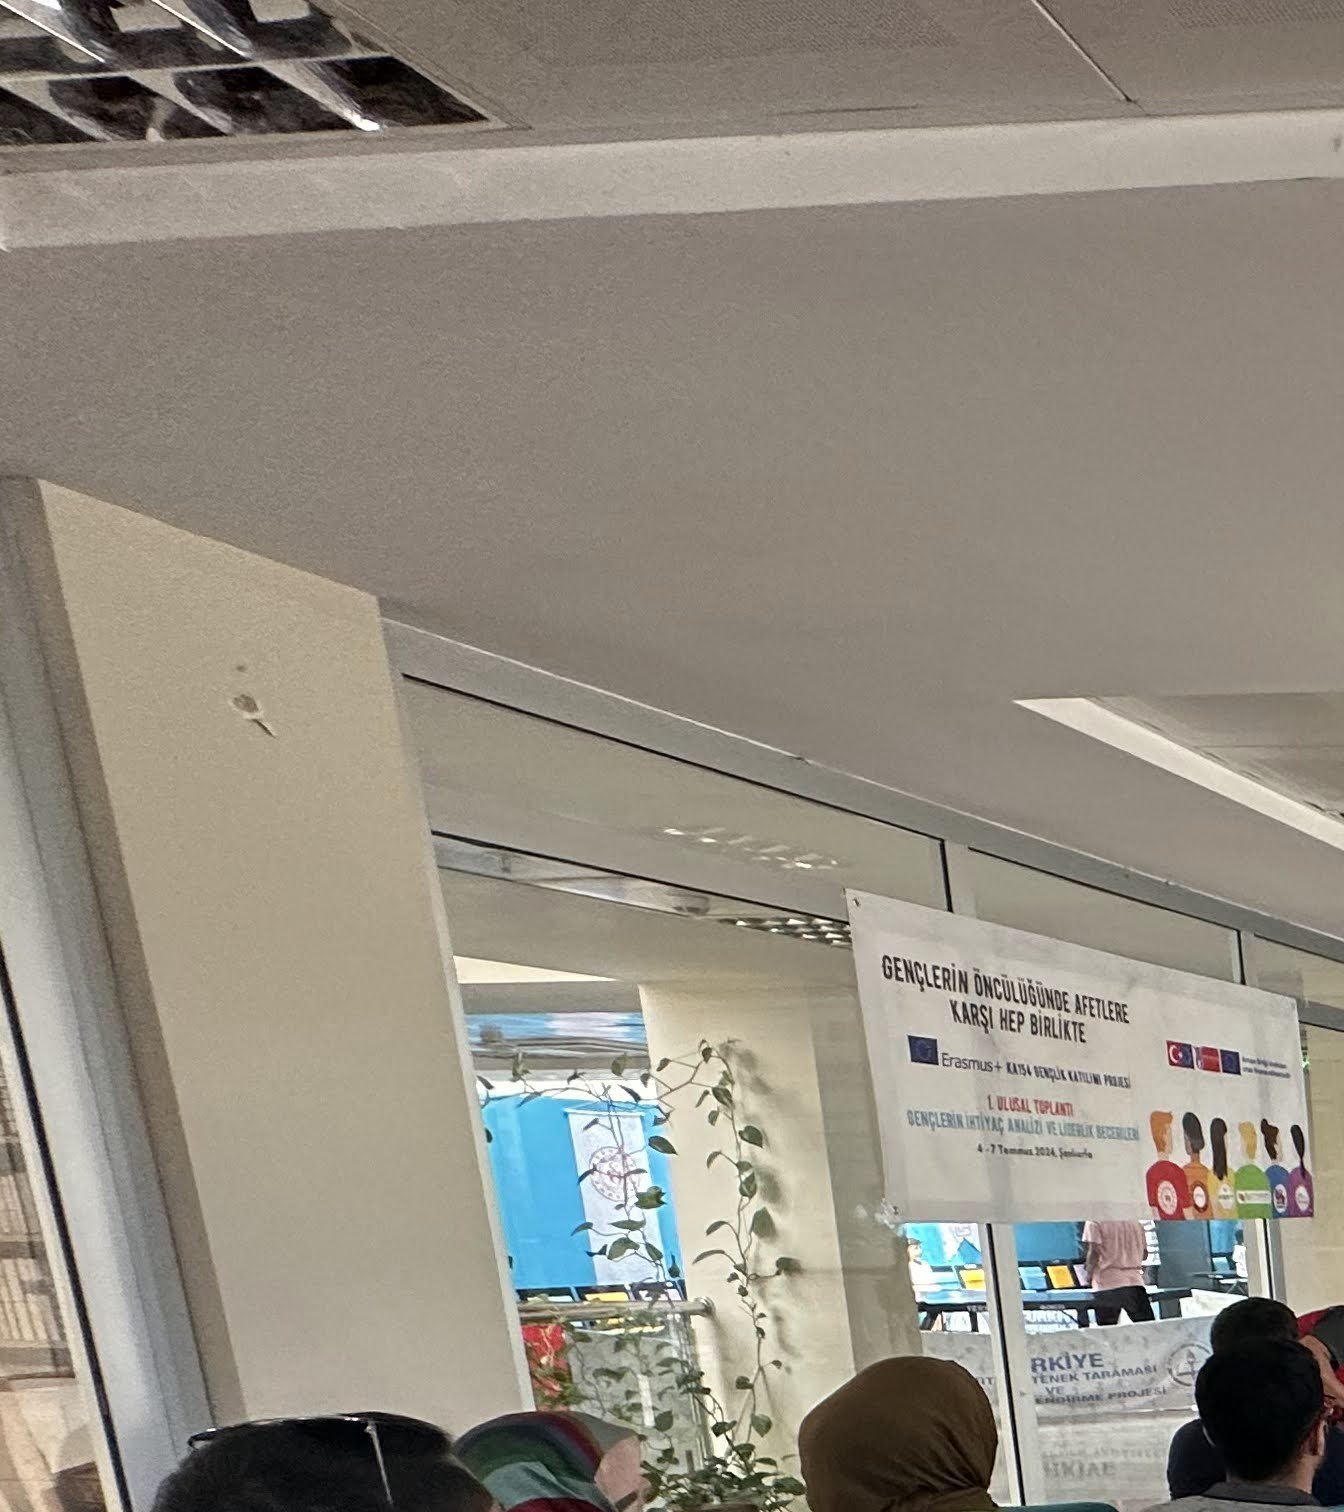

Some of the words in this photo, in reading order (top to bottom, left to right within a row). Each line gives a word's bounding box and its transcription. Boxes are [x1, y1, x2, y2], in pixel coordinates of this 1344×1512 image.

[882, 954, 968, 994] GENÇLERİN
[973, 967, 1071, 1013] ÖNCÜLÜĞÜNDE
[1075, 994, 1130, 1024] AFETLERE
[949, 999, 994, 1034] KARŞI
[1000, 1008, 1024, 1033] HEP
[1030, 1010, 1087, 1043] BİRLİKTE
[941, 1053, 1002, 1073] Erasmus+
[997, 1096, 1031, 1113] ULUSAL
[1034, 1099, 1073, 1116] TOPLANTI
[1031, 1352, 1104, 1373] RKİYE
[1032, 1373, 1079, 1385] TENEK
[1085, 1365, 1157, 1381] TARAMASI
